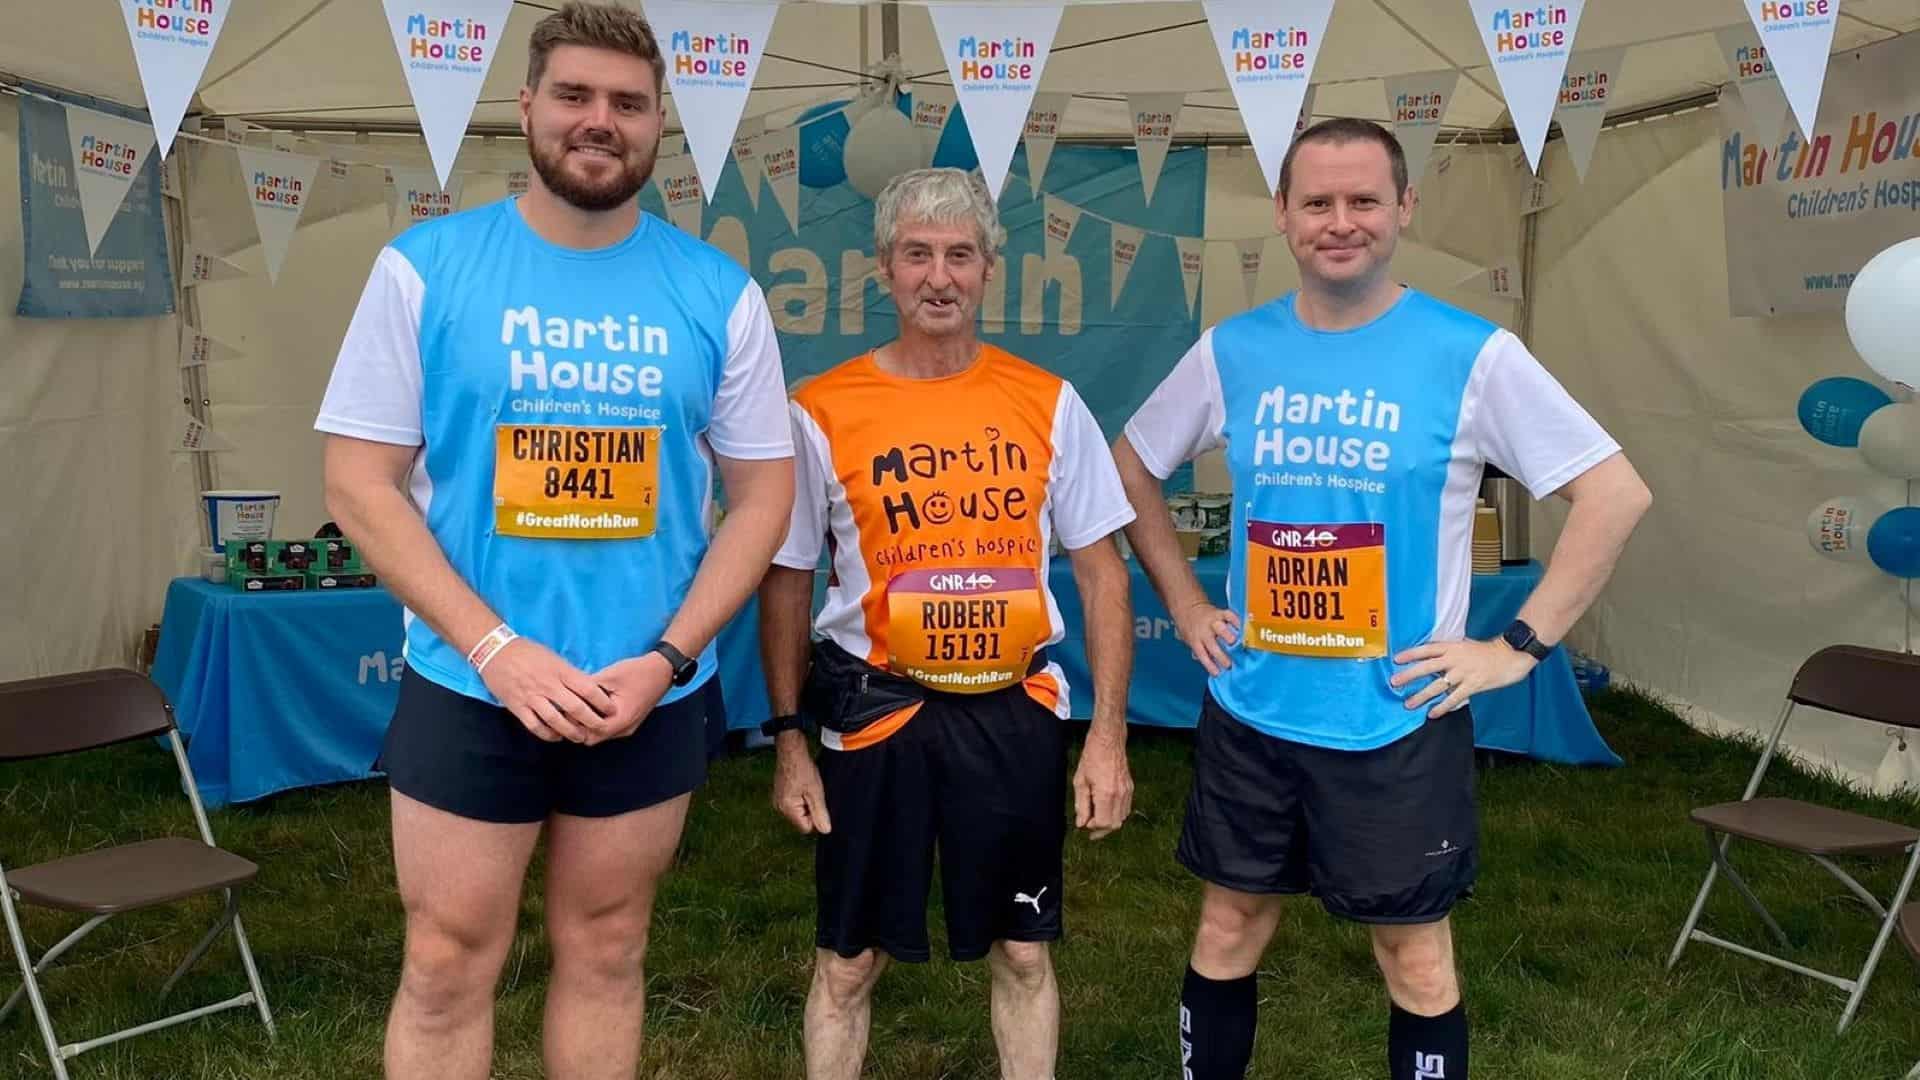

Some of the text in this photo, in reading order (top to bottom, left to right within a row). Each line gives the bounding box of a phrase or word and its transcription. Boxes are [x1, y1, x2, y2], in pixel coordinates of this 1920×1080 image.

[138, 8, 209, 34] House
[1493, 6, 1566, 30] Martin
[1762, 0, 1828, 21] House
[407, 13, 485, 40] Martin
[1231, 26, 1307, 50] Martin
[411, 38, 482, 62] House
[671, 30, 749, 54] Martin
[958, 36, 1034, 58] Martin
[1498, 30, 1564, 53] House
[676, 55, 746, 76] House
[962, 61, 1031, 80] House
[1236, 51, 1304, 72] House
[1396, 92, 1441, 107] Martin
[1559, 88, 1605, 104] House
[1397, 108, 1439, 121] House
[82, 135, 136, 160] Martin
[1722, 112, 1920, 191] Martin Hou
[82, 150, 132, 174] House
[254, 171, 302, 191] Martin
[256, 186, 299, 205] House
[408, 190, 450, 205] Martin
[1787, 183, 1870, 219] Children's
[502, 305, 668, 356] Martin
[511, 350, 663, 397] House
[512, 398, 661, 420] Children's Hospice
[1255, 385, 1400, 432] Martin
[513, 428, 645, 463] CHRISTIAN
[873, 428, 1027, 487] Martin
[1254, 427, 1391, 471] House
[545, 466, 614, 499] 8441
[1255, 472, 1385, 494] Children's Hospice
[516, 511, 639, 529] #GreatNorthRun
[876, 537, 966, 566] children's
[1267, 556, 1348, 587] ADRIAN
[922, 600, 1008, 629] ROBERT
[1270, 589, 1344, 620] 13081
[926, 633, 1001, 661] 15131
[1260, 628, 1365, 647] #GreatNorthRun
[358, 651, 404, 684] Ma
[907, 667, 1013, 686] #GreatNorthRun
